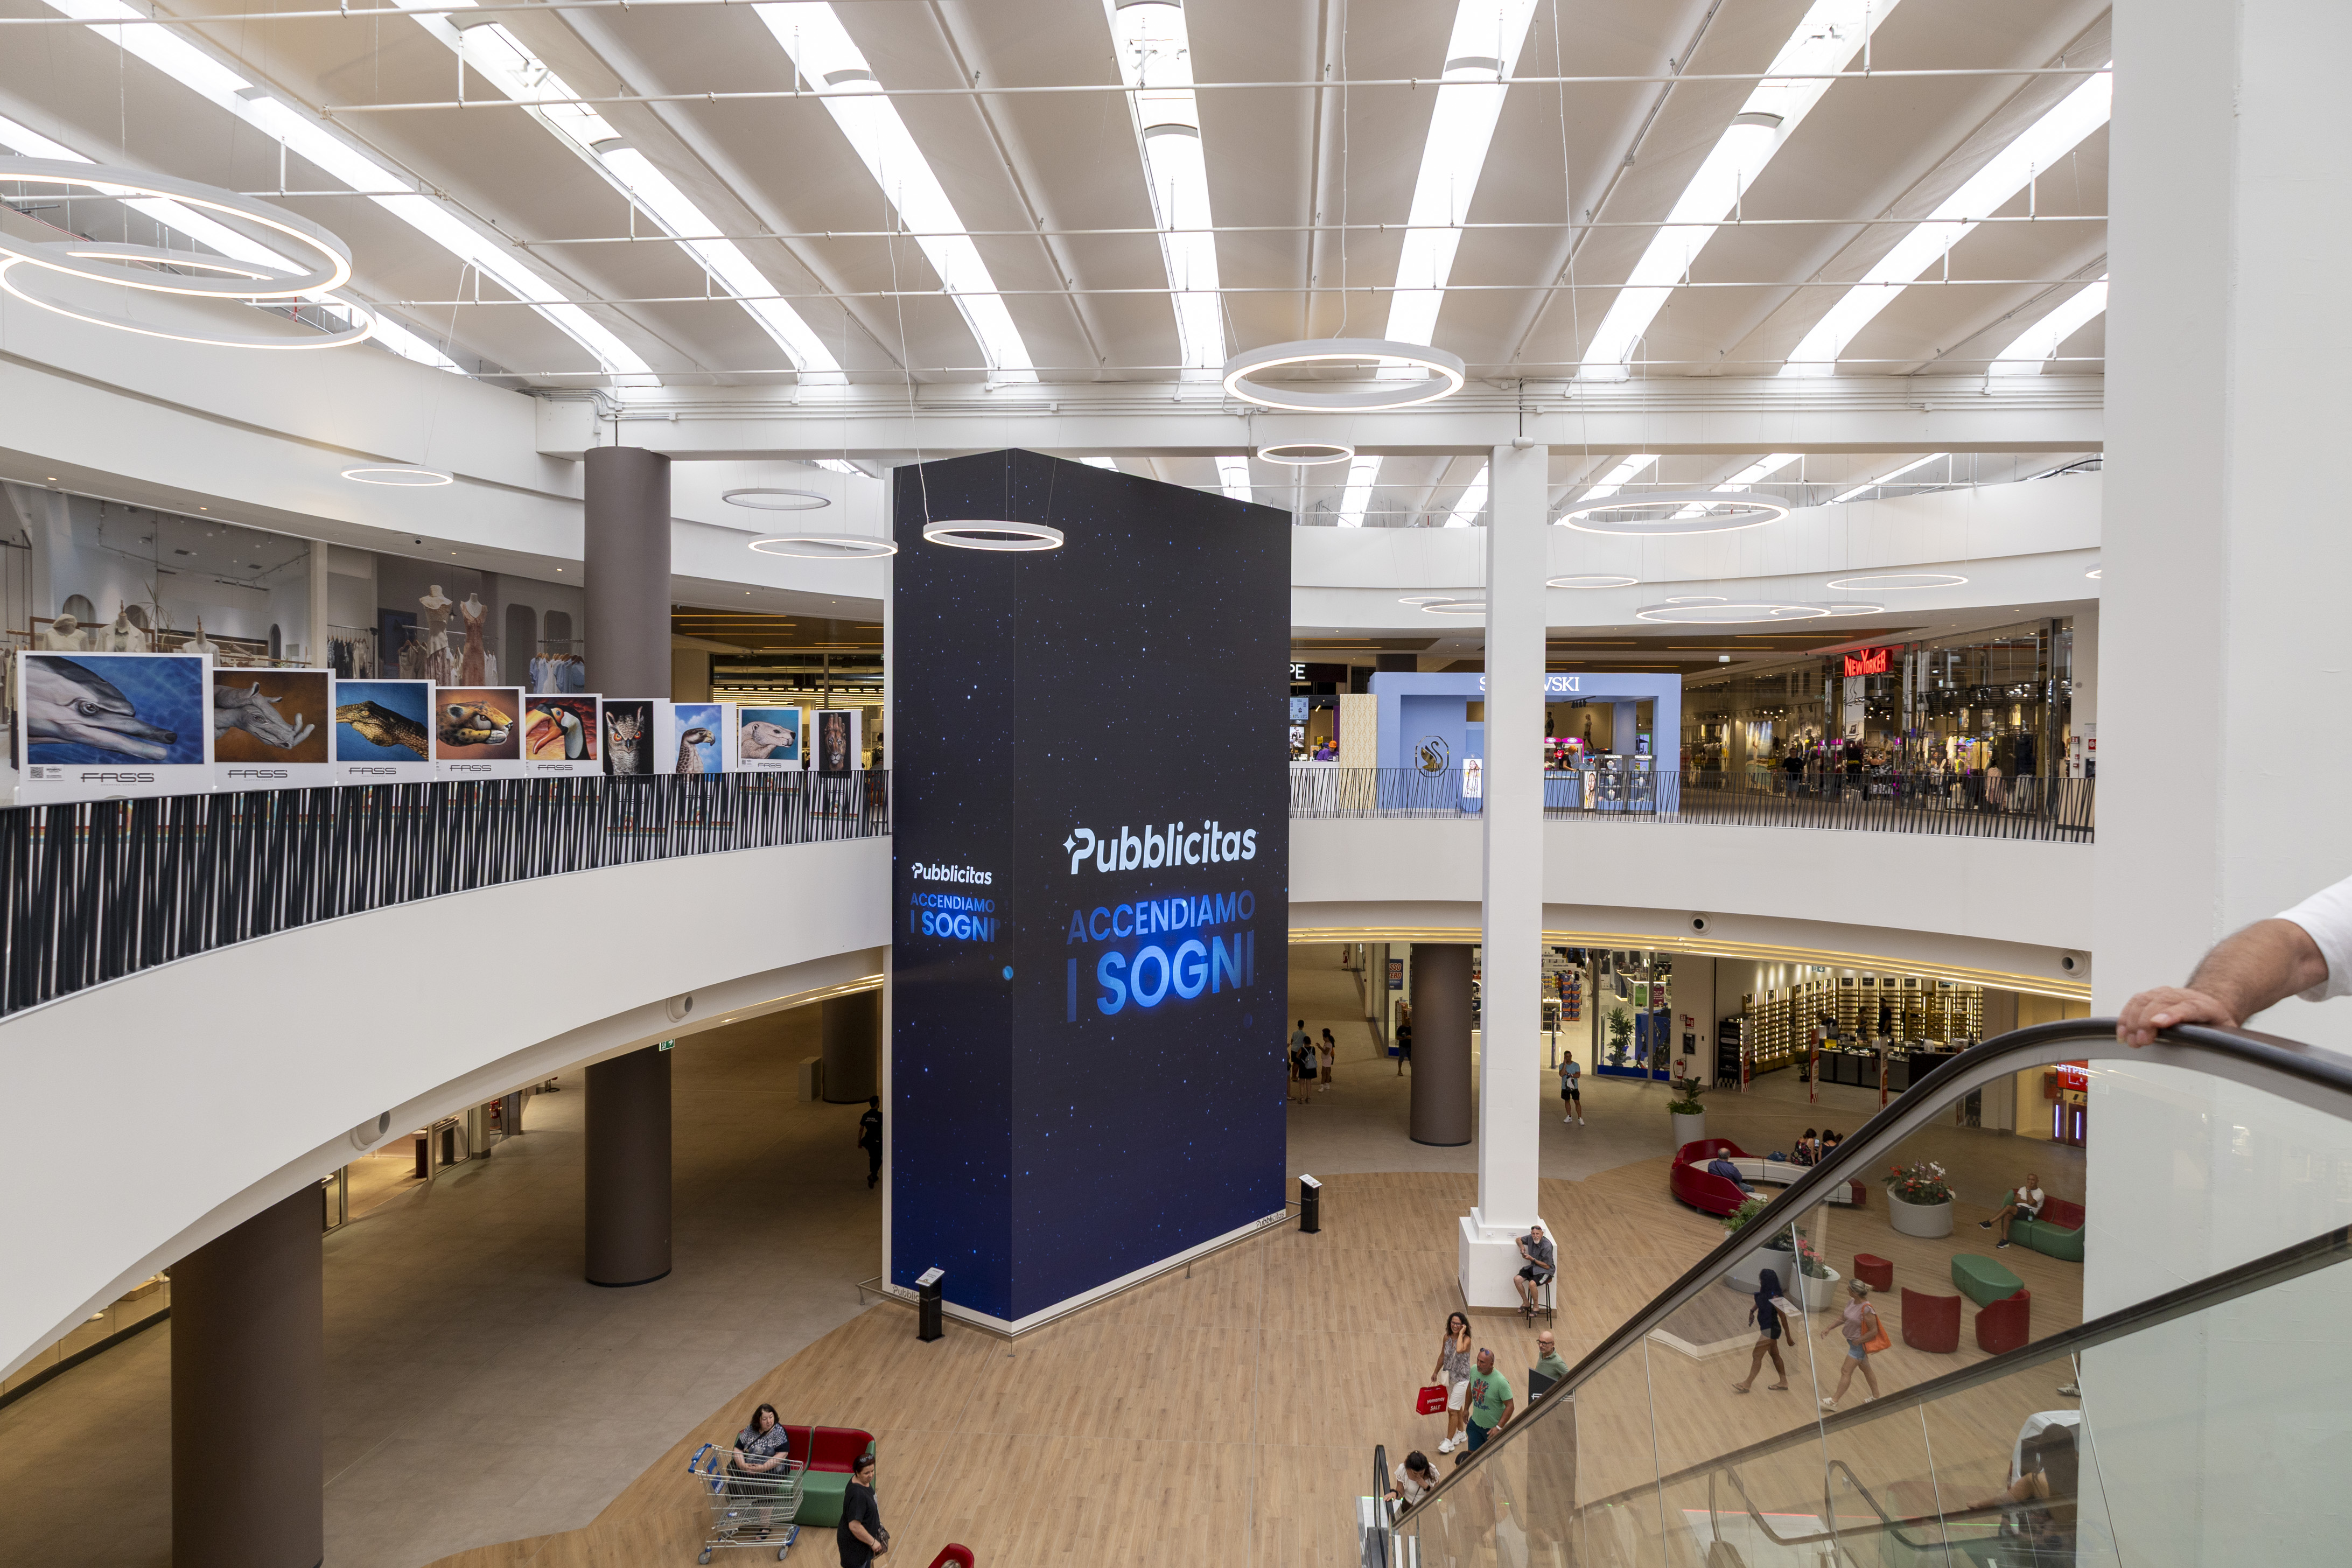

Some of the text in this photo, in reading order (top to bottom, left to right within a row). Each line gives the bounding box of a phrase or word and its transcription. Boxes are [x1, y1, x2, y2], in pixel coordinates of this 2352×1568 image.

[80, 773, 155, 782] FASS
[227, 770, 288, 778] FASS
[1070, 820, 1257, 874] Pubblicitas
[914, 862, 992, 885] Pubblicitas
[911, 892, 995, 913] ACCENDIAMO
[911, 909, 995, 942] I SOGNI
[1067, 890, 1255, 945] ACCENDIAMO
[1067, 930, 1254, 1023] I SOGNI
[1256, 1212, 1285, 1228] Pubblicitas
[894, 1285, 919, 1302] Pubblic
